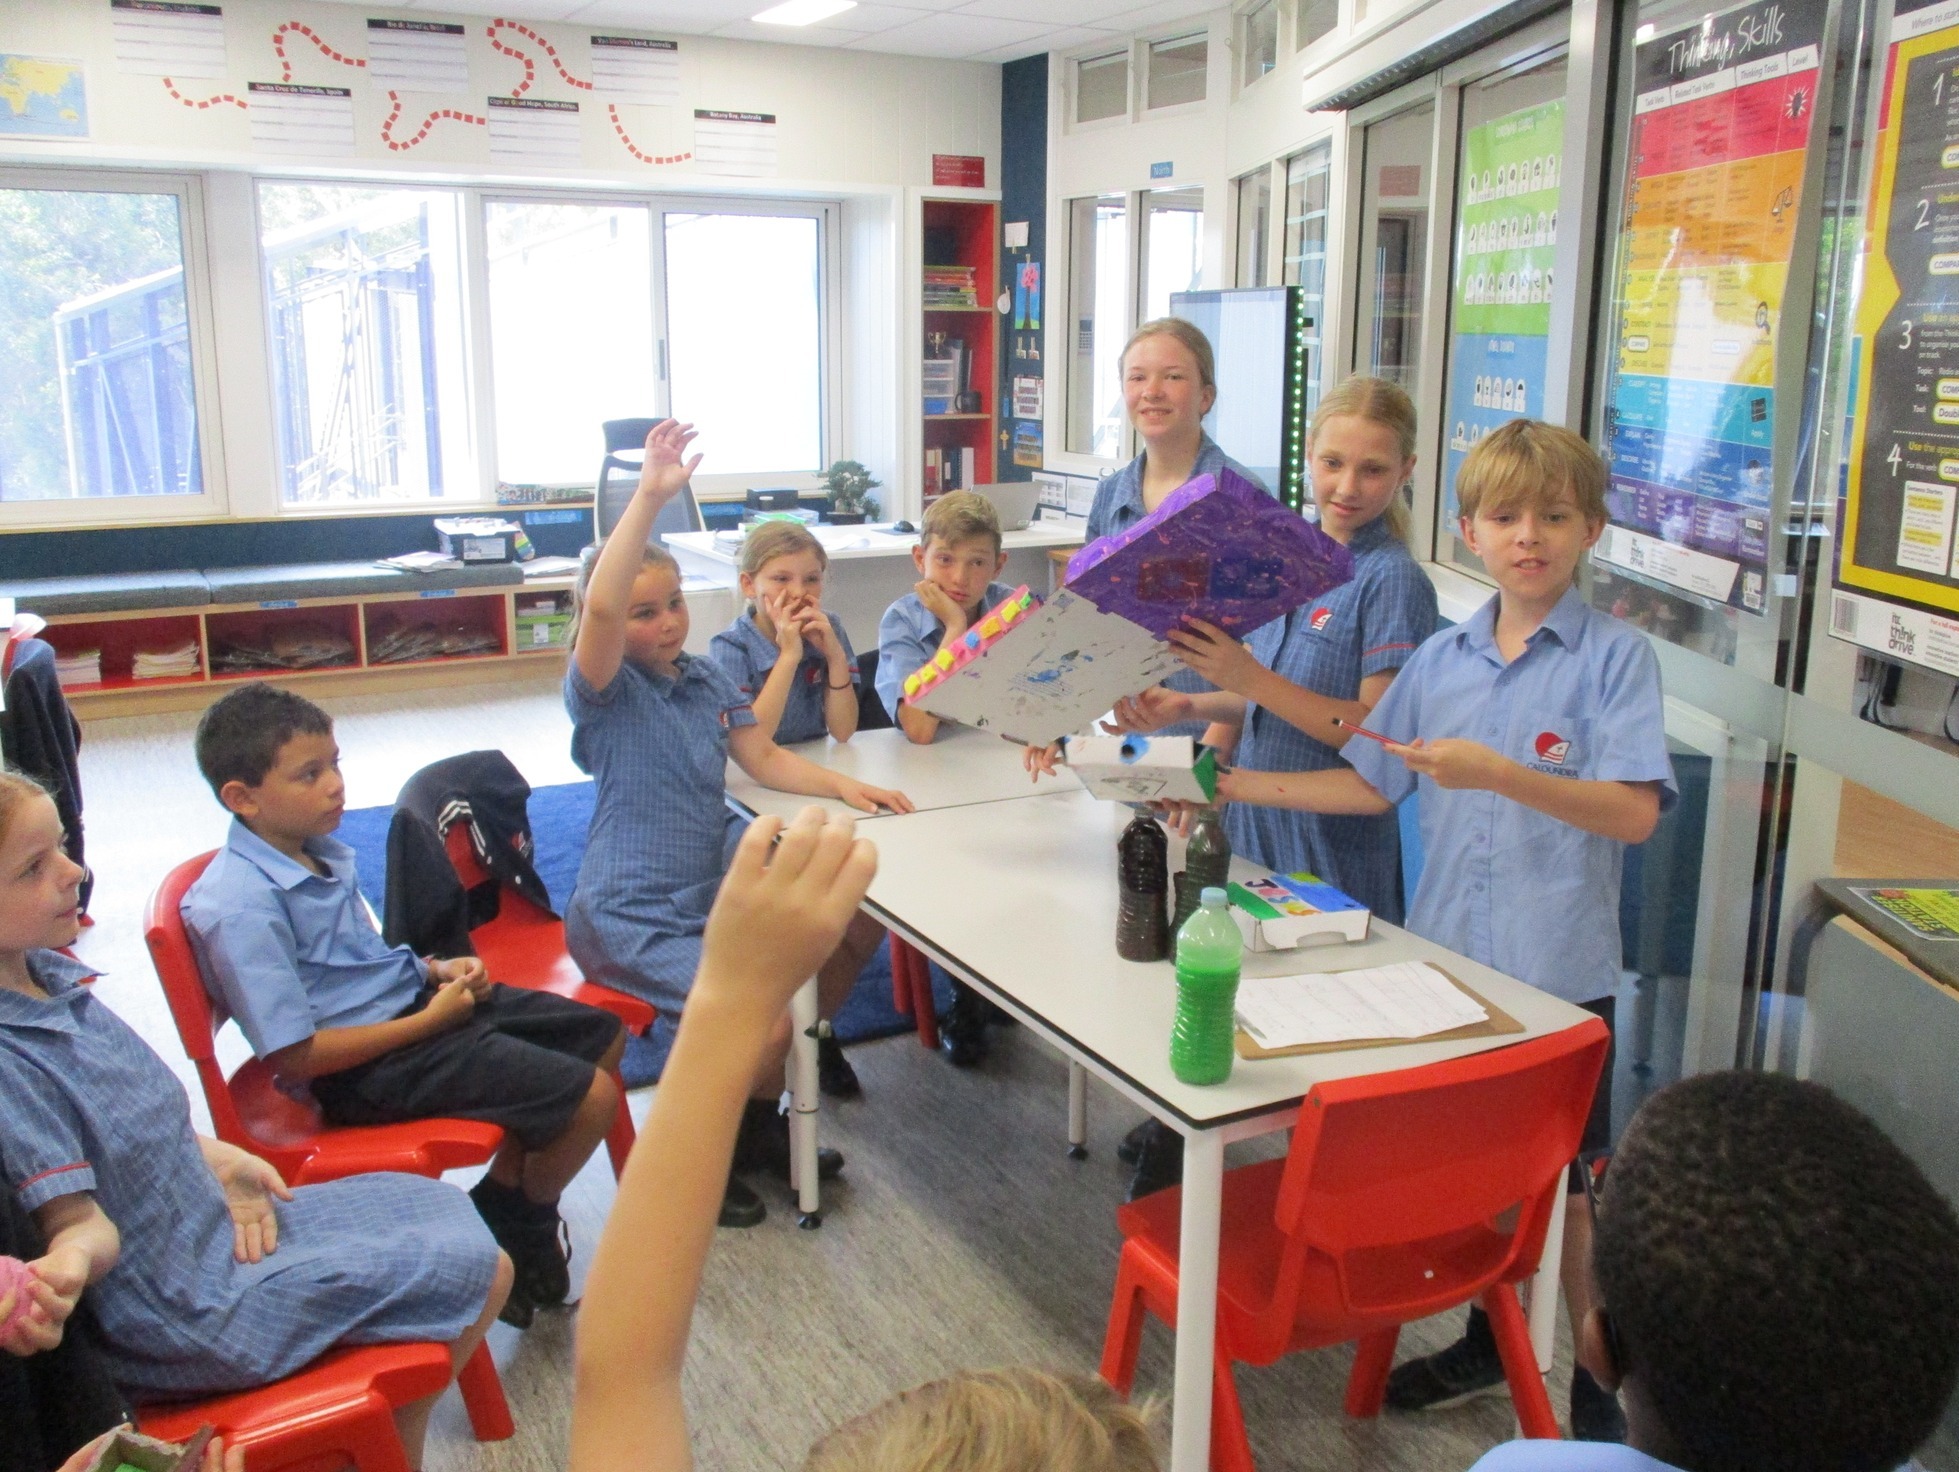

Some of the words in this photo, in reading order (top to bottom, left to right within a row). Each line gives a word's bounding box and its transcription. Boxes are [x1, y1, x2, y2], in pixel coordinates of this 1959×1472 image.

[1738, 5, 1785, 54] Skills
[275, 84, 289, 92] Cruz
[1741, 67, 1762, 79] Thinking
[1932, 72, 1945, 106] 1
[1914, 198, 1930, 231] 2
[1898, 319, 1912, 350] 3
[1886, 443, 1903, 477] 4
[1908, 440, 1923, 451] Use
[1888, 638, 1914, 656] drive
